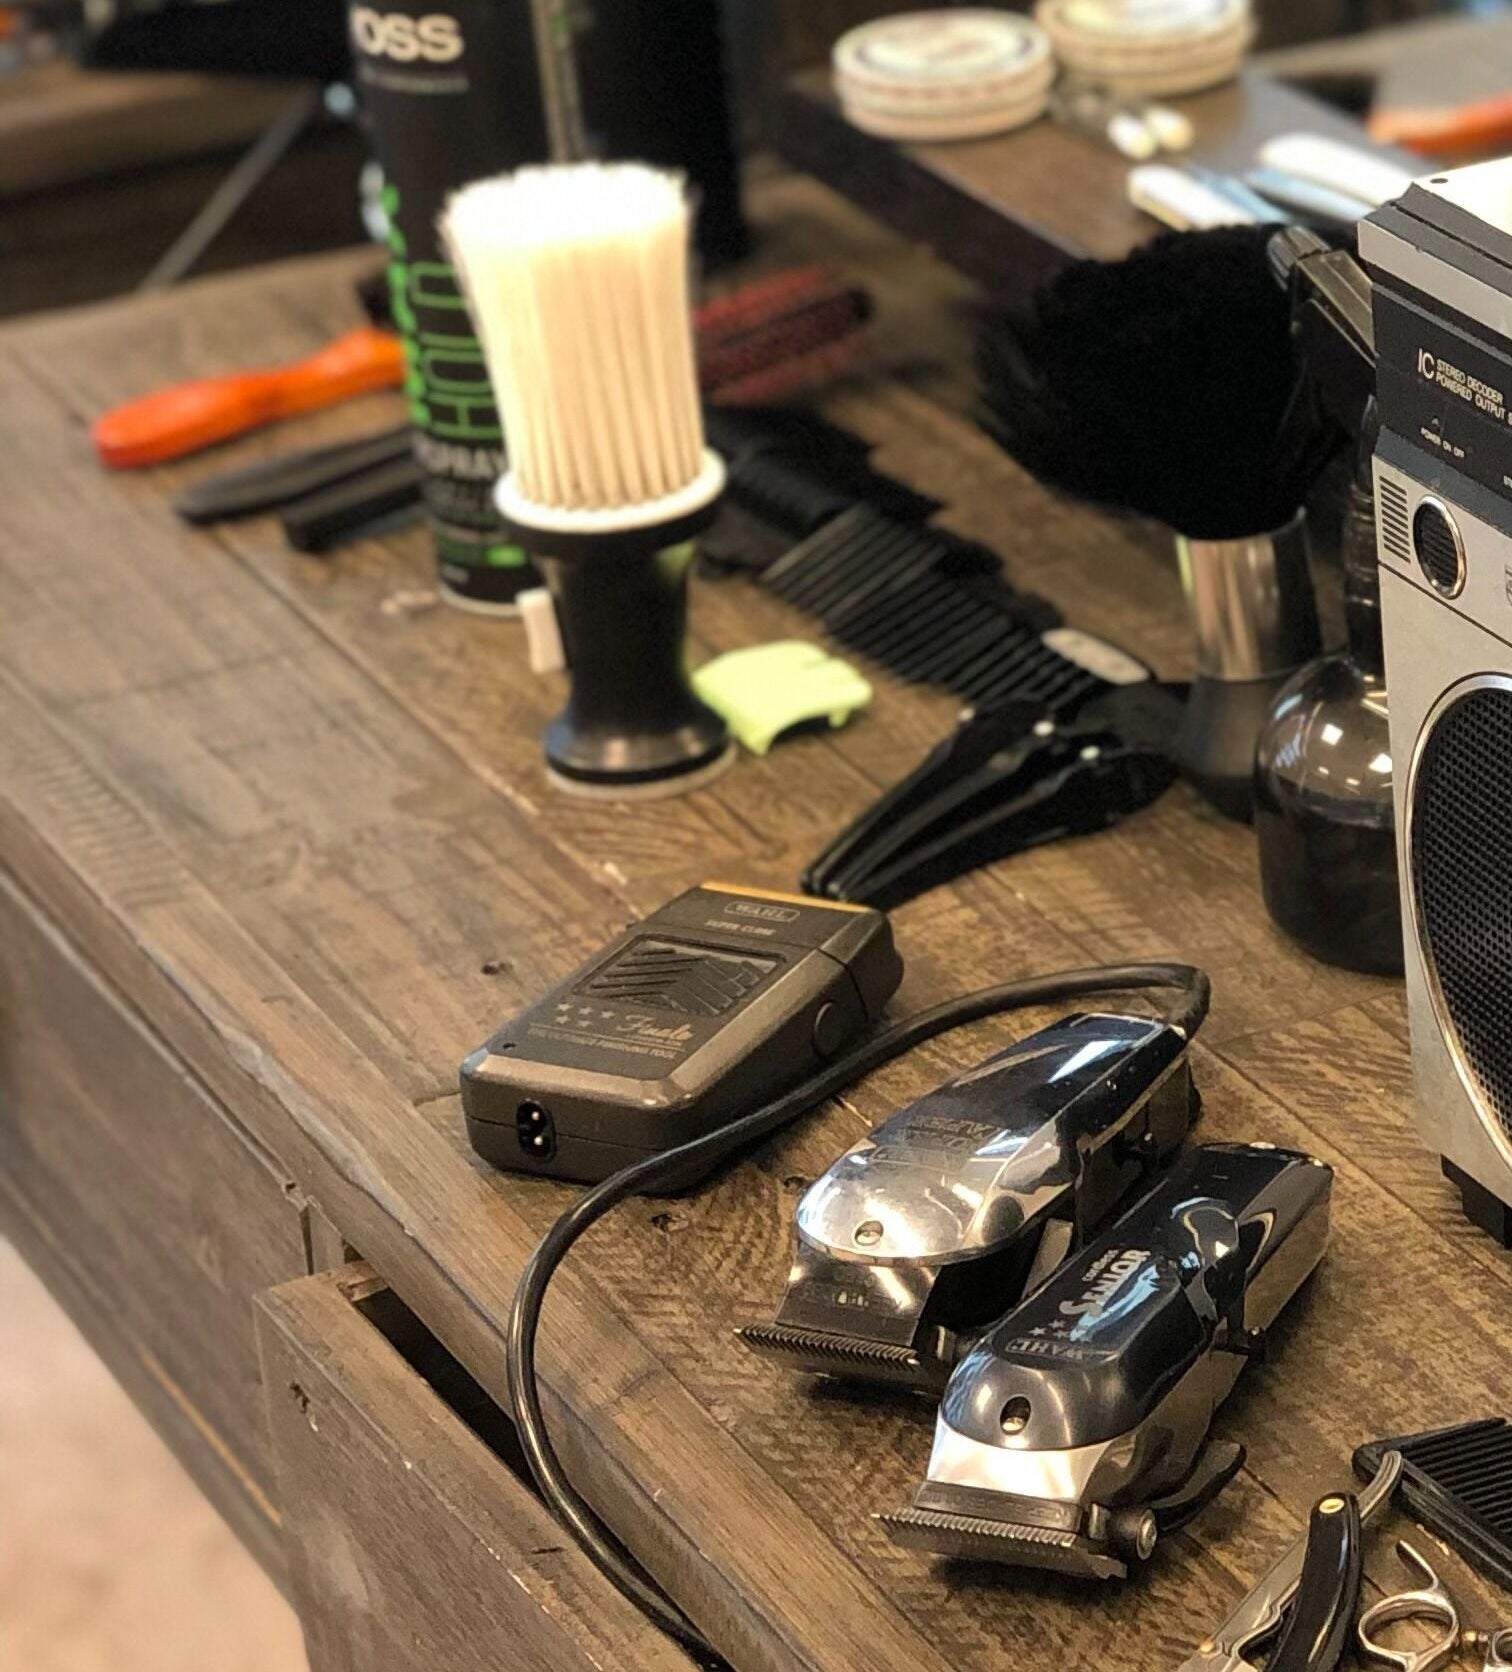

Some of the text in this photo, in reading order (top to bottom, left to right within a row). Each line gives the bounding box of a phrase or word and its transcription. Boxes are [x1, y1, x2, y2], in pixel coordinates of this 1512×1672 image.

[1417, 348, 1434, 379] IC
[1436, 359, 1503, 405] STEREO DECODER
[1436, 371, 1473, 401] POWERED
[1474, 394, 1506, 419] OUTPUT
